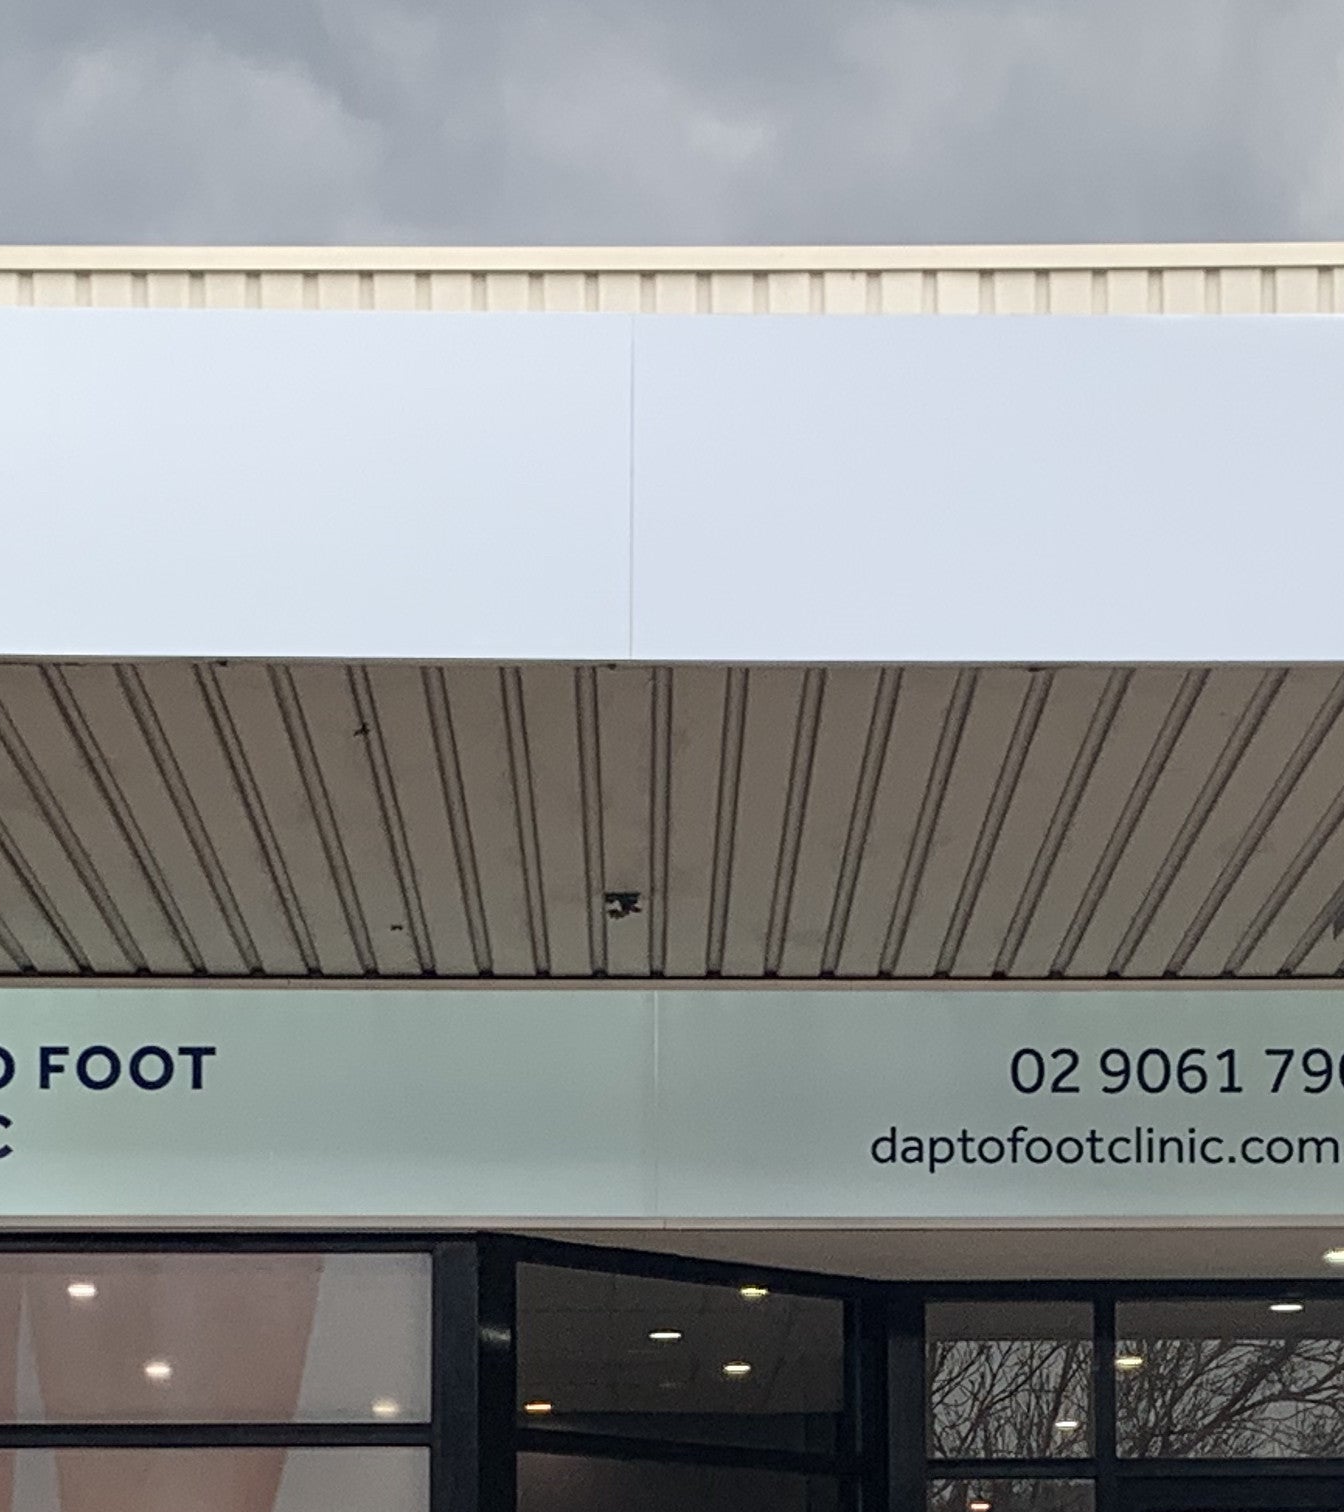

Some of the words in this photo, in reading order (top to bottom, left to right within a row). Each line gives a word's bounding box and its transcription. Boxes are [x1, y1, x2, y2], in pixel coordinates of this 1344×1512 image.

[39, 1045, 216, 1091] FOOT
[1010, 1047, 1082, 1094] 02
[1099, 1047, 1244, 1094] 9061
